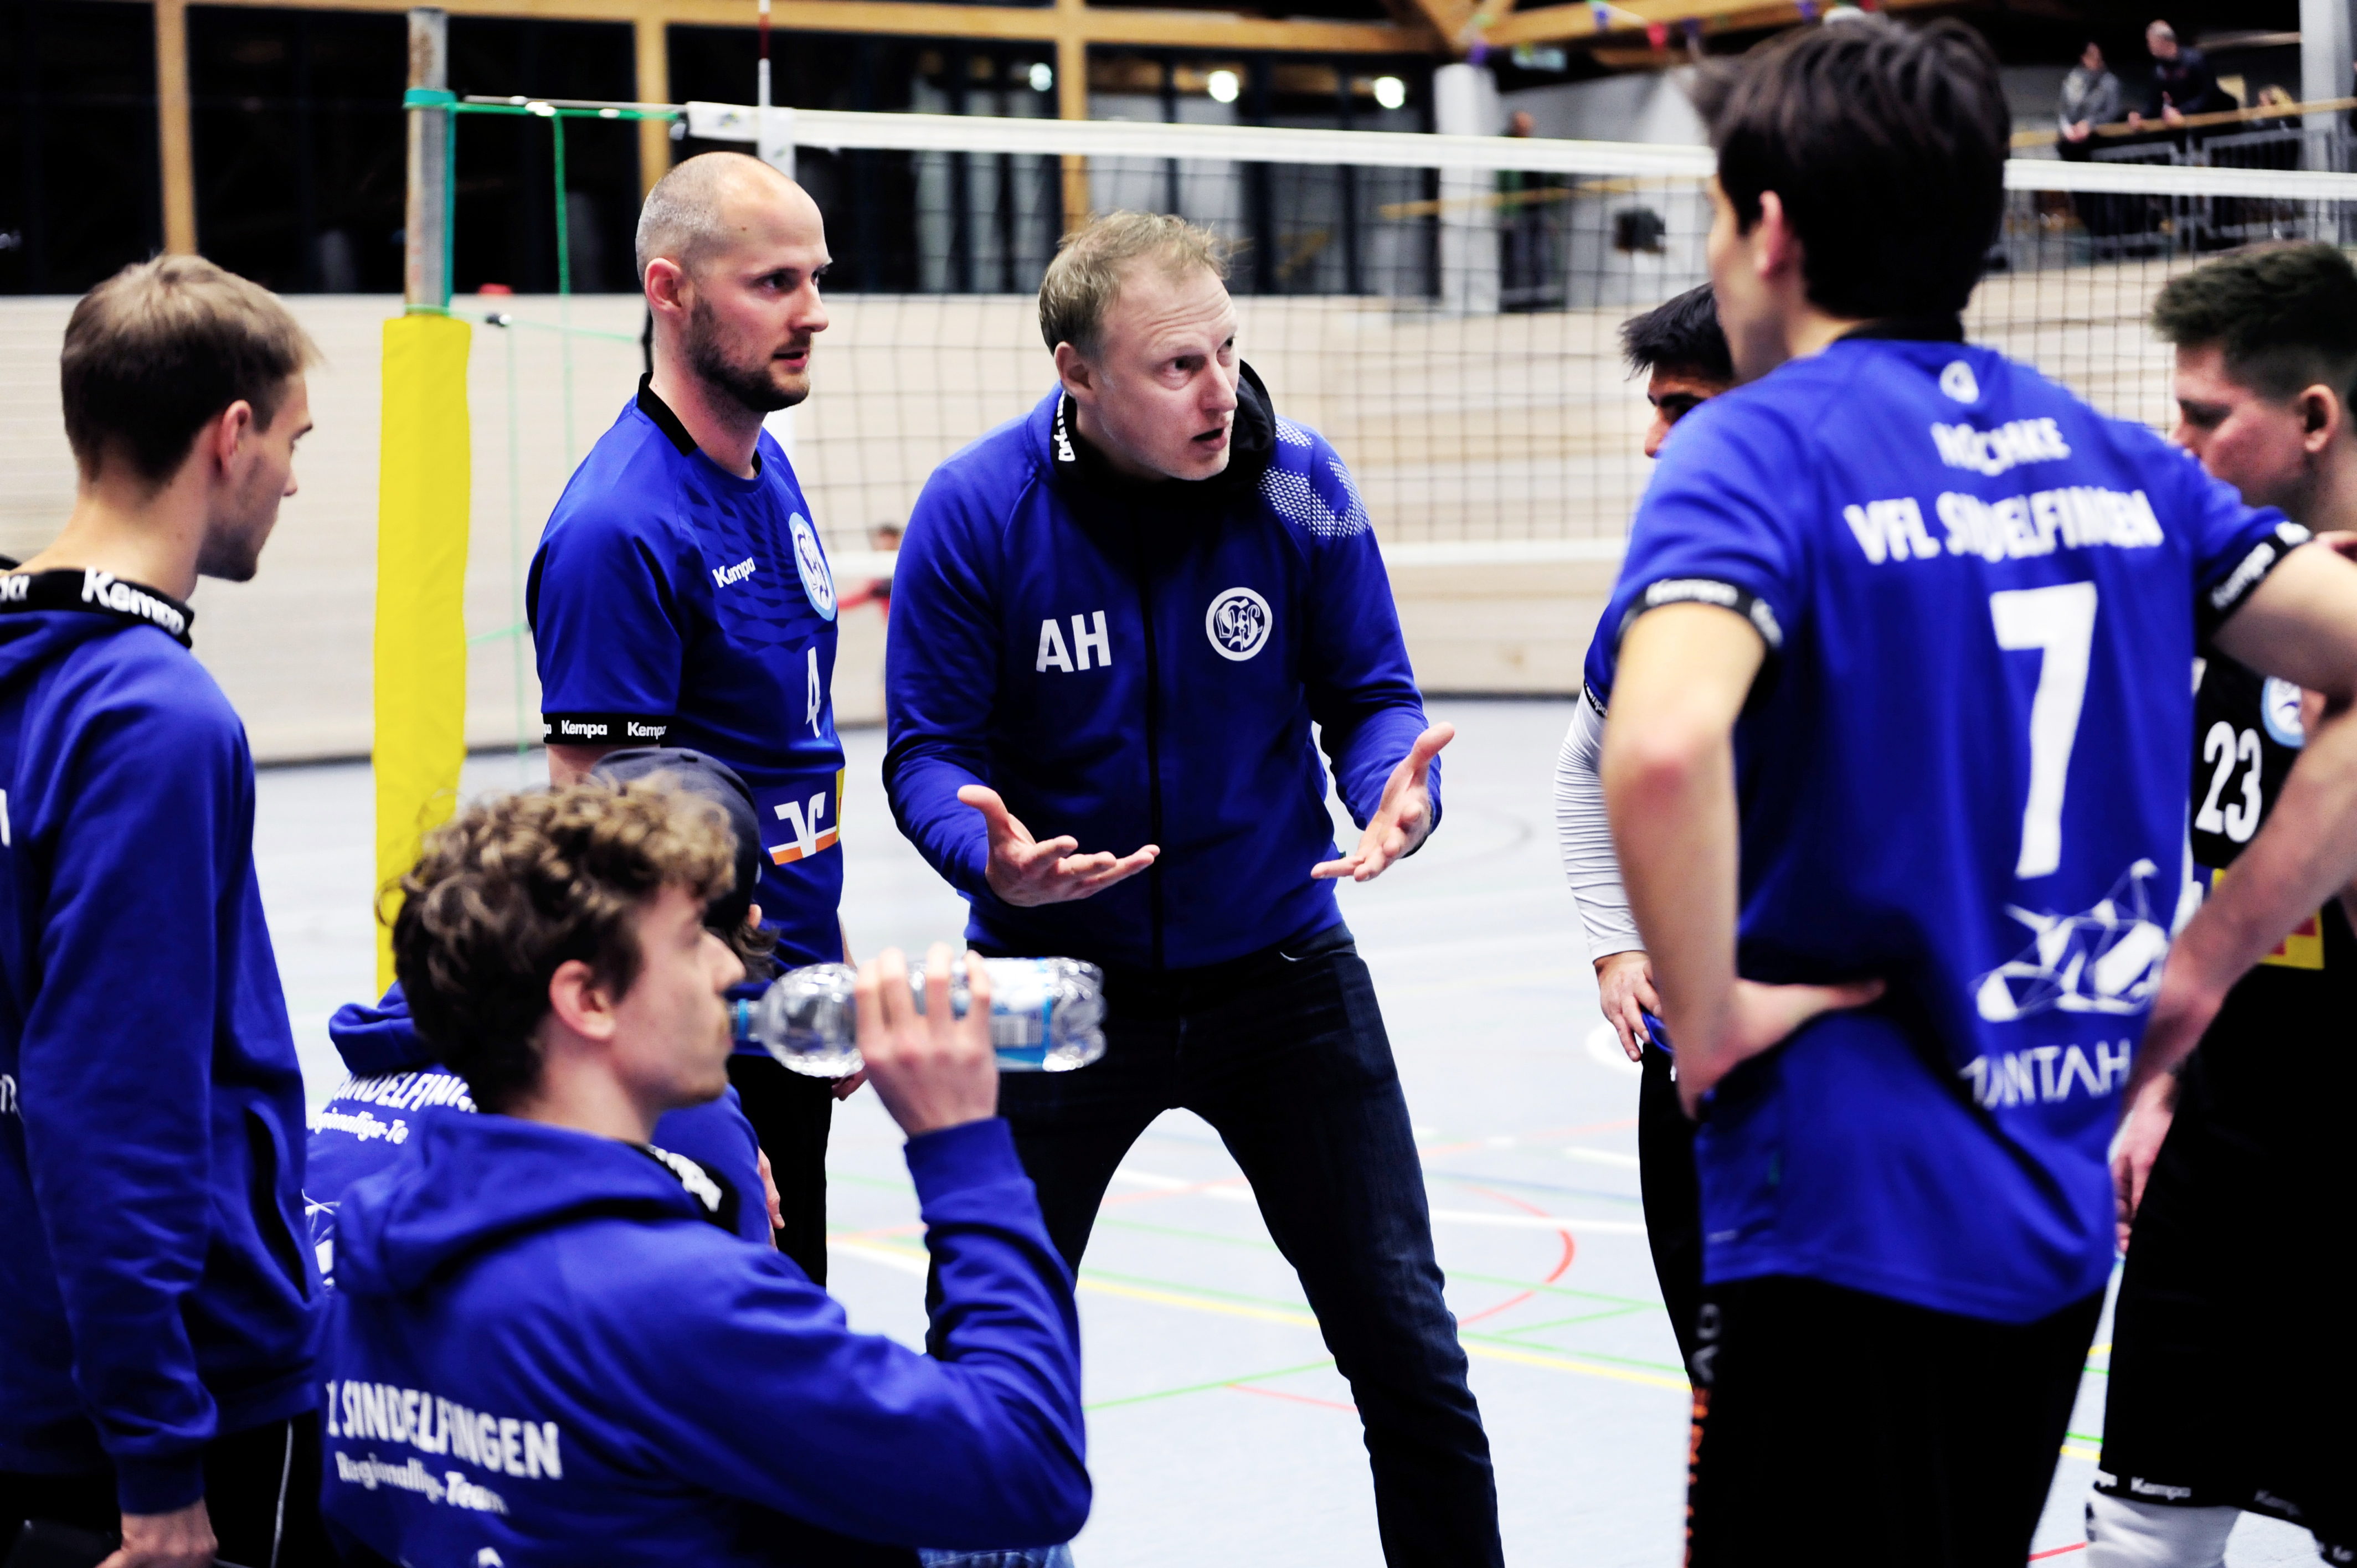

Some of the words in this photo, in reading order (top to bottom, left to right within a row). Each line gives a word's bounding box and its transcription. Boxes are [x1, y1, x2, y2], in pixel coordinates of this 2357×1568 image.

[1843, 496, 1941, 565] VFL
[712, 556, 756, 588] Kempa
[1036, 610, 1112, 673] AH
[562, 720, 608, 739] Kempa
[627, 721, 667, 740] Kempa
[1989, 580, 2098, 880] 7
[2195, 721, 2262, 843] 23
[342, 1379, 563, 1479] SINDELFINGEN
